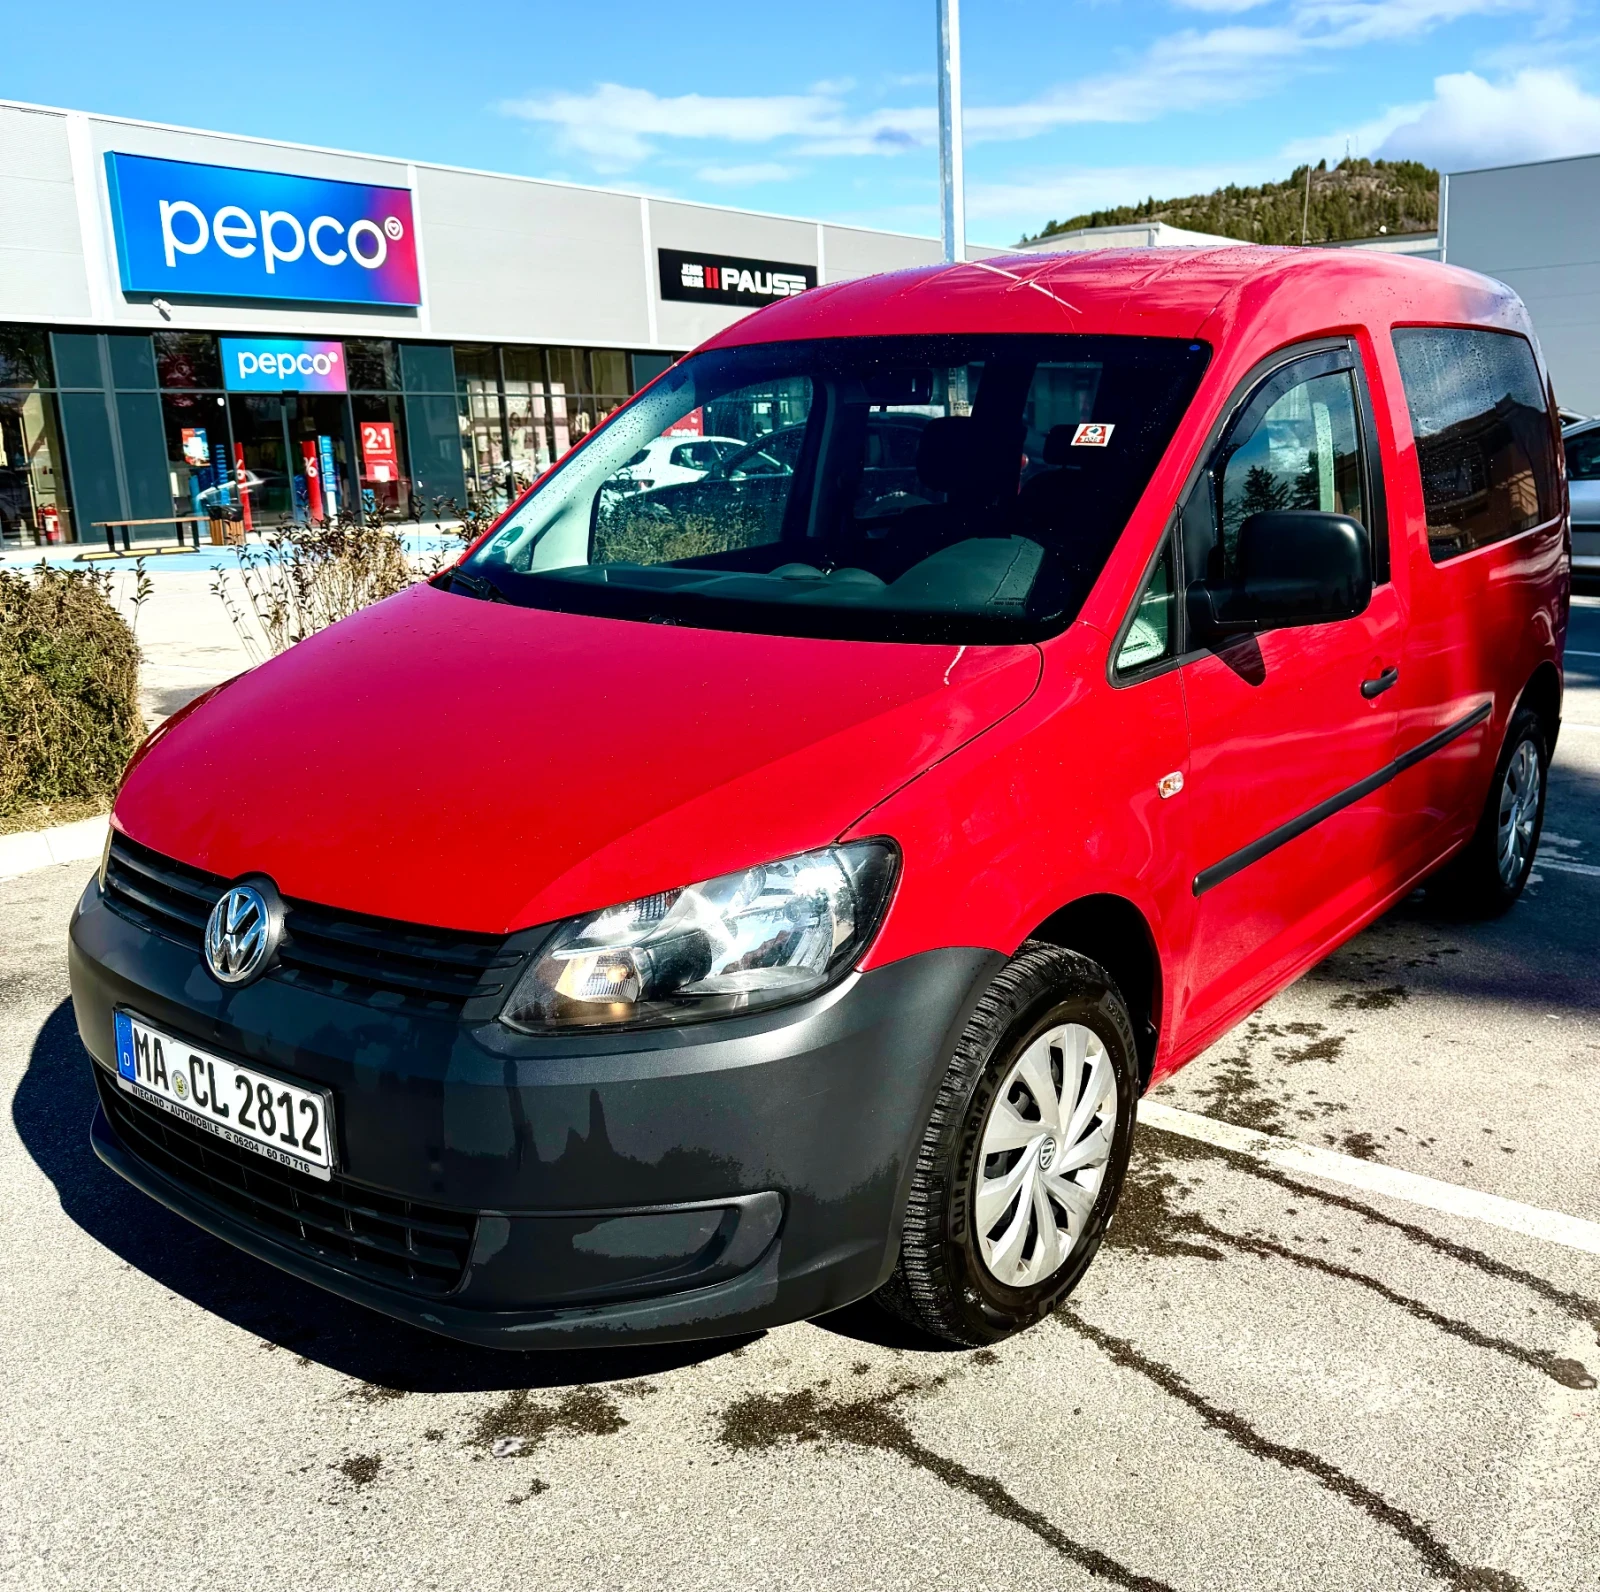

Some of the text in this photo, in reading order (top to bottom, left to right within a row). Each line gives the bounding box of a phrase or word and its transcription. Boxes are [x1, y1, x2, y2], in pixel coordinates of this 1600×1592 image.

[159, 199, 387, 274] pepco
[720, 267, 807, 297] PAUSE
[237, 351, 332, 380] pepco
[364, 427, 392, 449] 2+1
[123, 1051, 131, 1067] D
[133, 1027, 322, 1157] MA CL 2812
[131, 1084, 165, 1109] WIEGAND
[171, 1104, 220, 1136] AUTOMOBILE
[233, 1134, 260, 1153] 06204
[266, 1148, 278, 1160] 60
[279, 1154, 291, 1166] 80
[293, 1159, 311, 1174] 716
